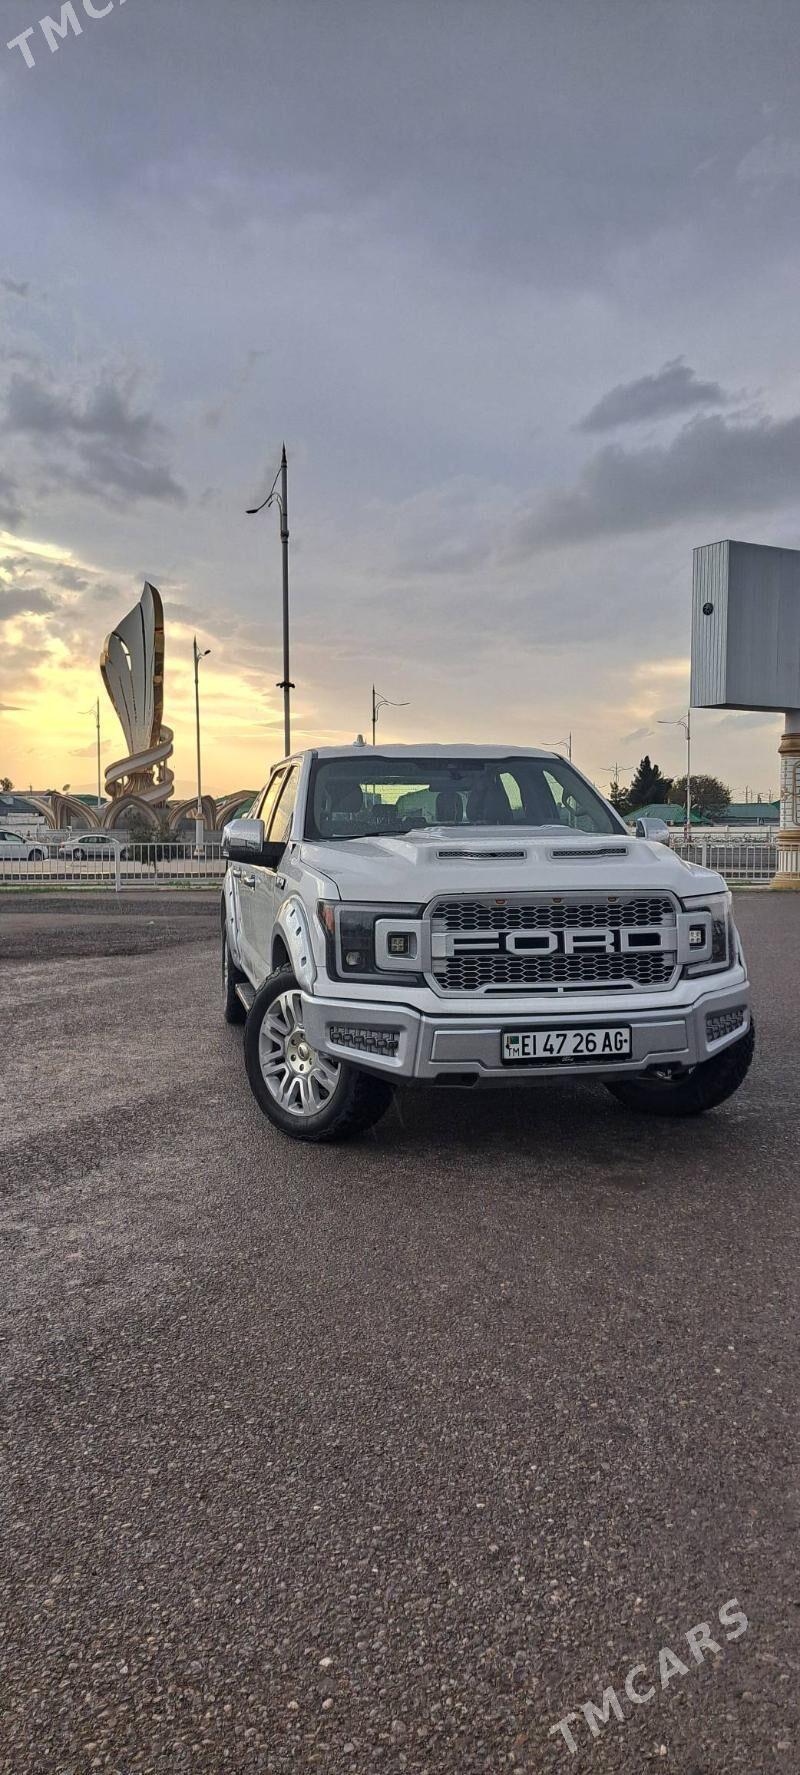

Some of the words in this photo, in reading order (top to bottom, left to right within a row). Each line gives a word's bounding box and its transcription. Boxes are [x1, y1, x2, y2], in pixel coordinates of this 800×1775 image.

[433, 928, 675, 957] FORD
[508, 1047, 520, 1057] TM
[521, 1034, 537, 1056] EI
[543, 1033, 568, 1055] 47
[572, 1032, 597, 1053] 26
[602, 1031, 624, 1052] AG
